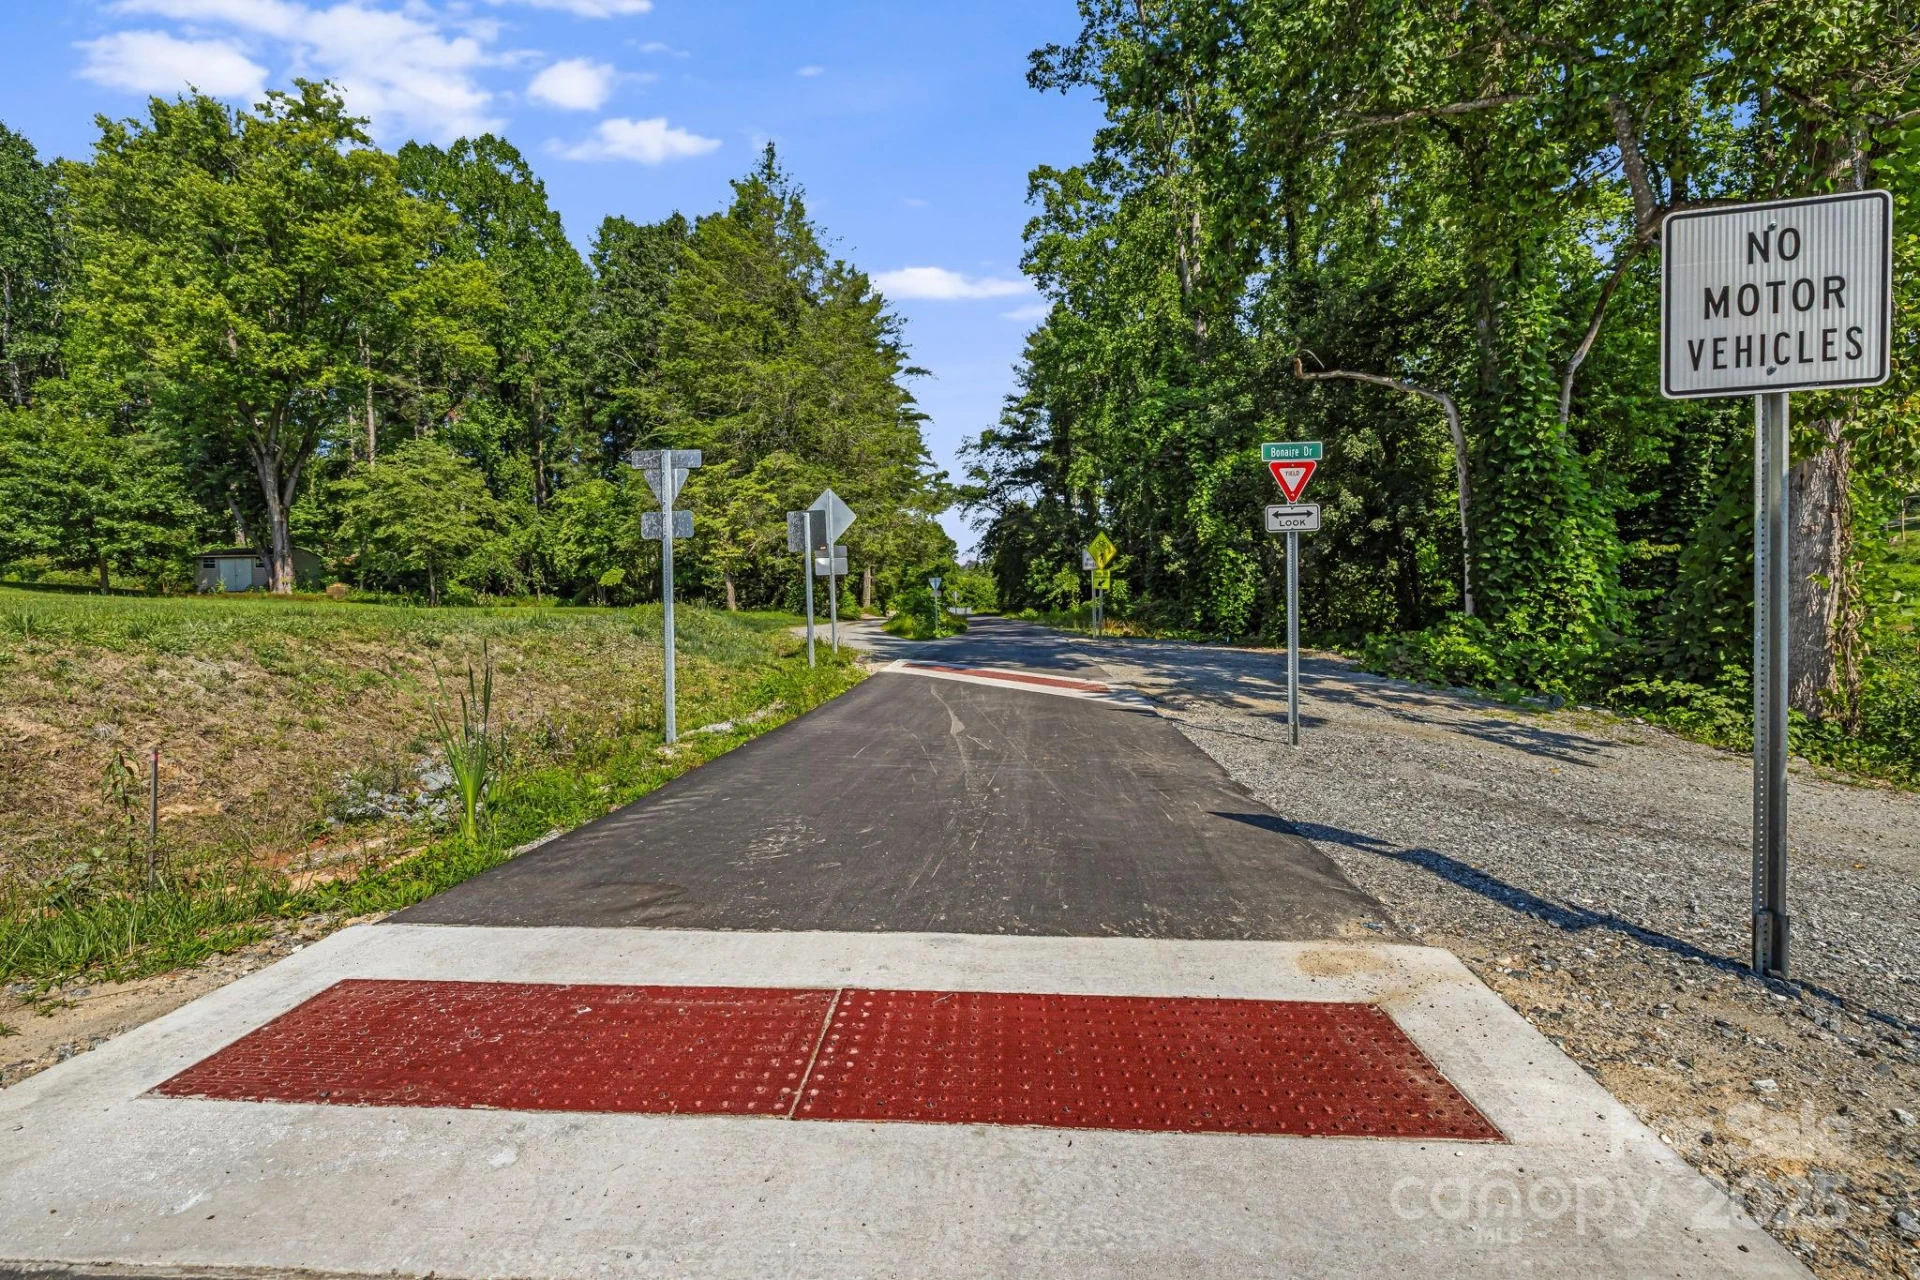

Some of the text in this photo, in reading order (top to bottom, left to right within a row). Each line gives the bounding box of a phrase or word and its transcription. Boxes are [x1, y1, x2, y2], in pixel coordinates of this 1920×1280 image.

[1747, 227, 1801, 265] NO
[1703, 275, 1846, 320] MOTOR
[1687, 326, 1863, 371] VEHICLES
[1271, 446, 1312, 457] Bonaire Dr
